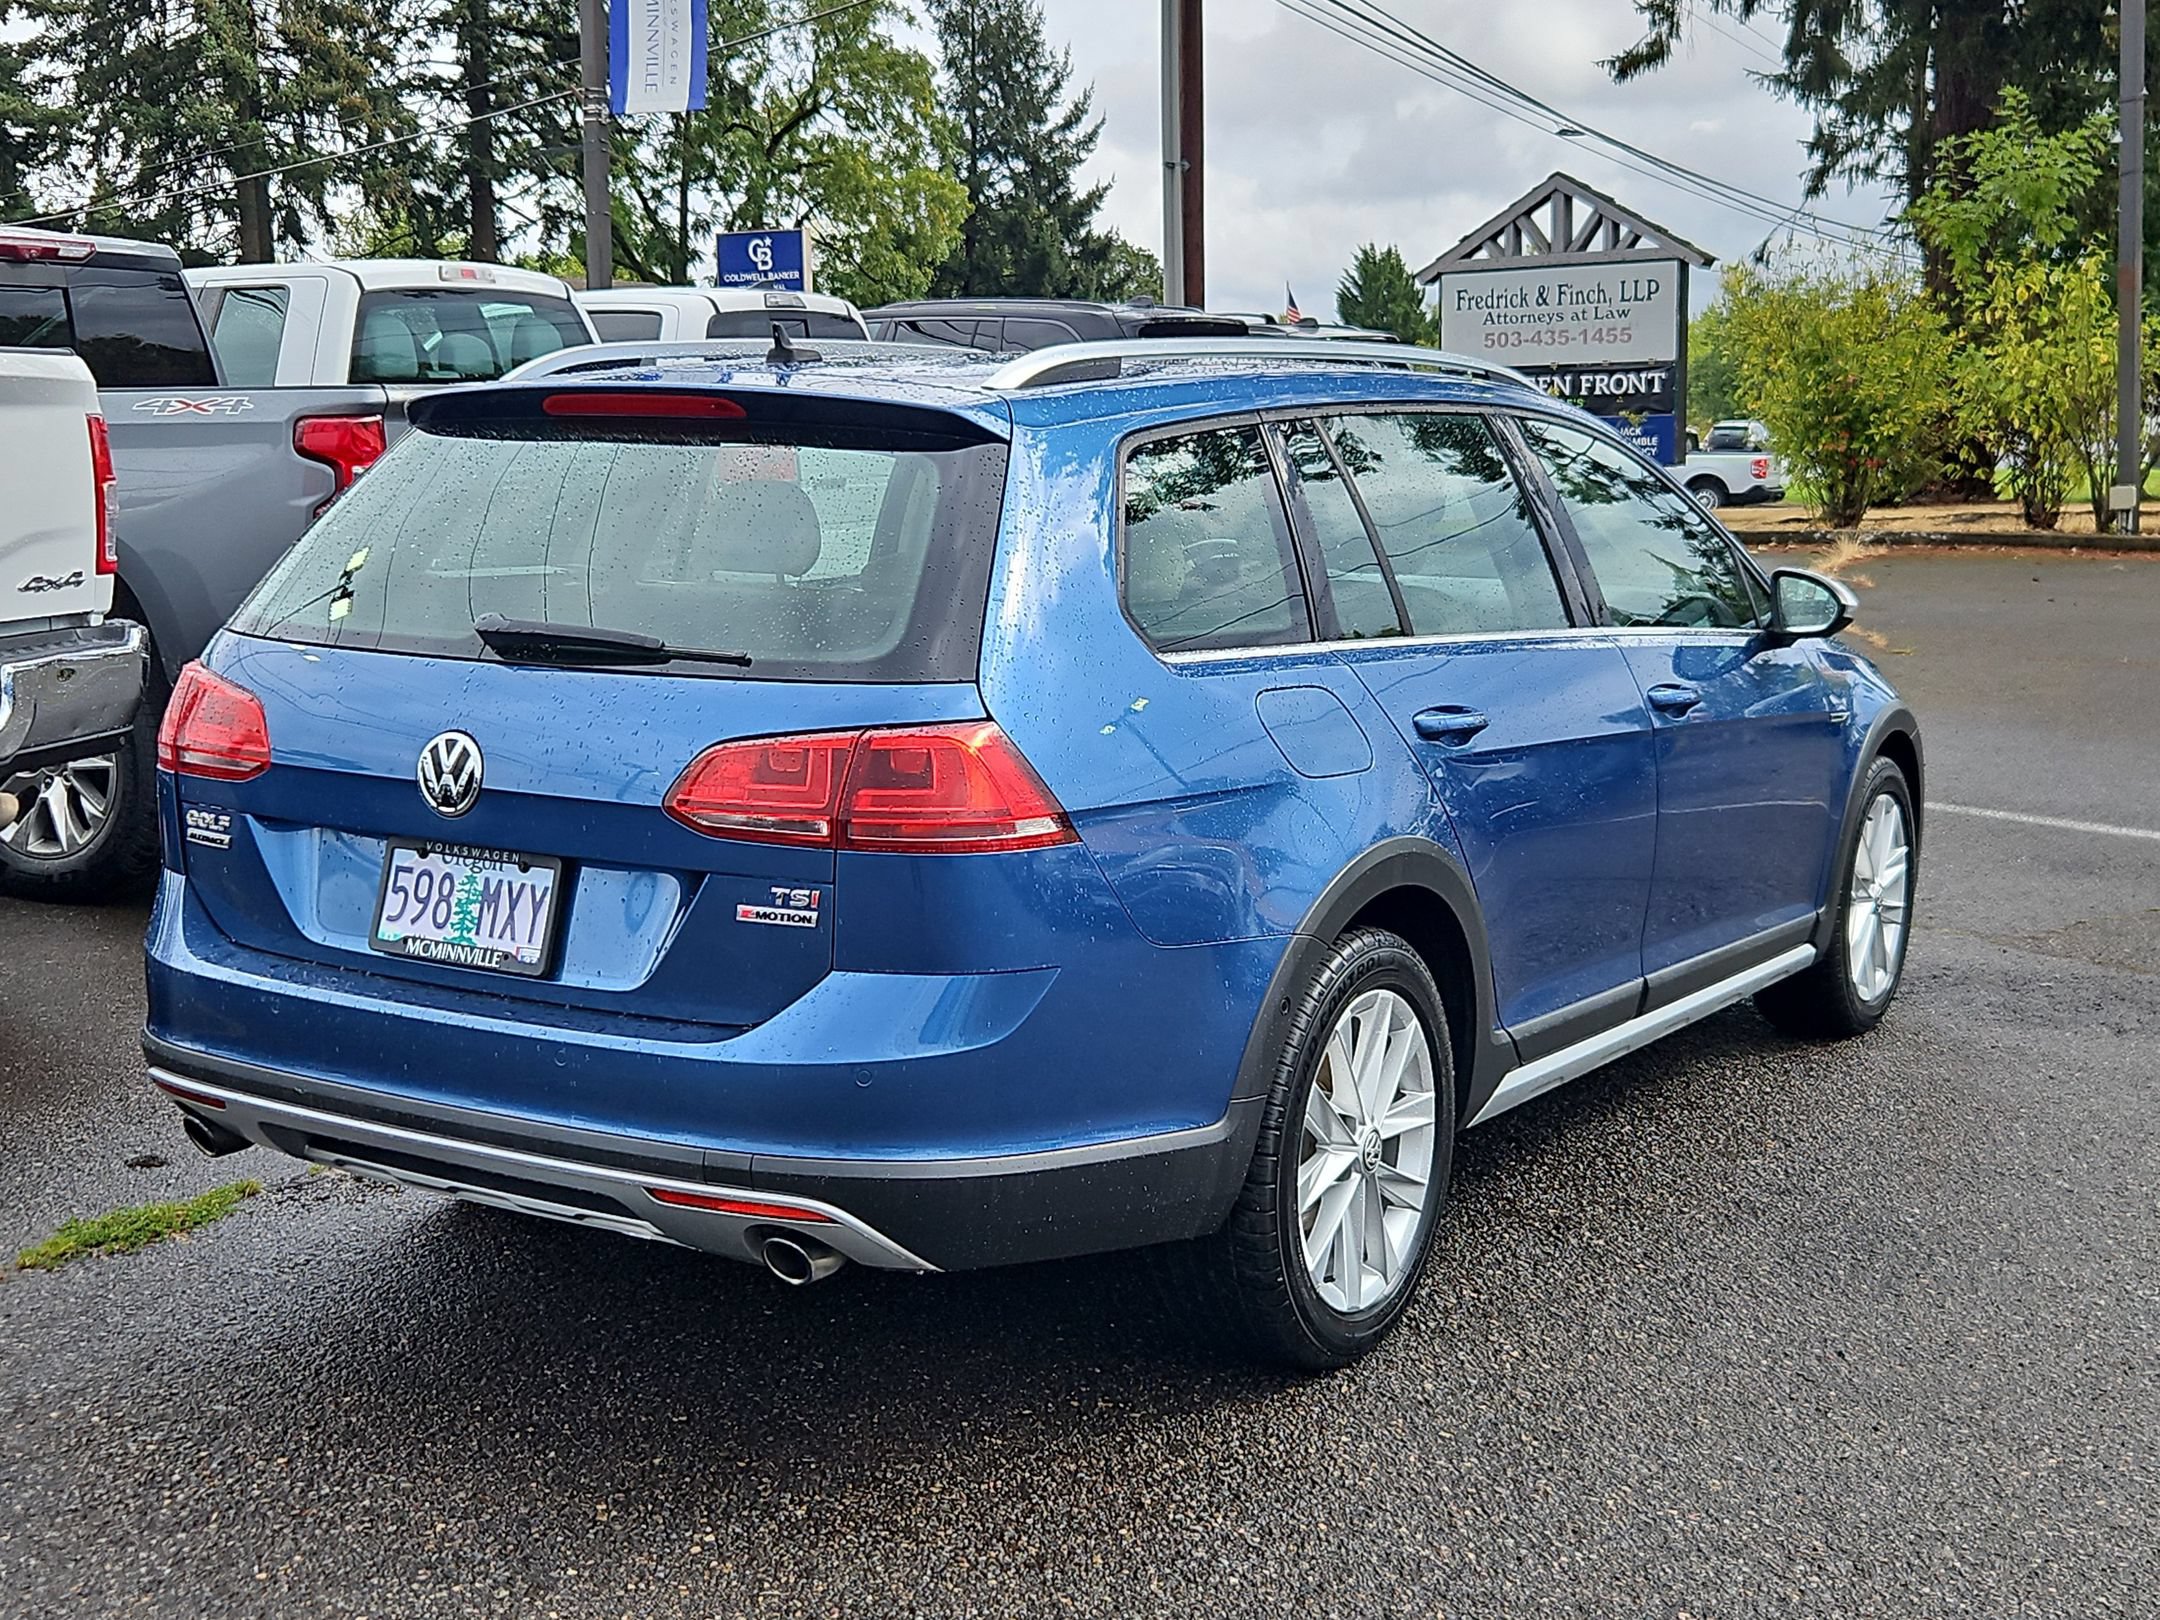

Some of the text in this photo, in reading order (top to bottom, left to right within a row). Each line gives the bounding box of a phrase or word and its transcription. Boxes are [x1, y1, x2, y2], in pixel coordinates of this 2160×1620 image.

[723, 271, 800, 283] COLDWELL BANKER
[1455, 279, 1660, 312] Fredrick & Finch, LLP
[1482, 306, 1631, 326] Attorneys at Law
[1484, 326, 1633, 349] 503-435-1455
[1579, 371, 1666, 396] FRONT
[186, 809, 231, 831] GOLF
[426, 841, 521, 863] VOLKSWAGEN
[386, 864, 549, 944] 598 MXY
[770, 886, 820, 909] TSI
[405, 937, 502, 968] MCMINNVILLE
